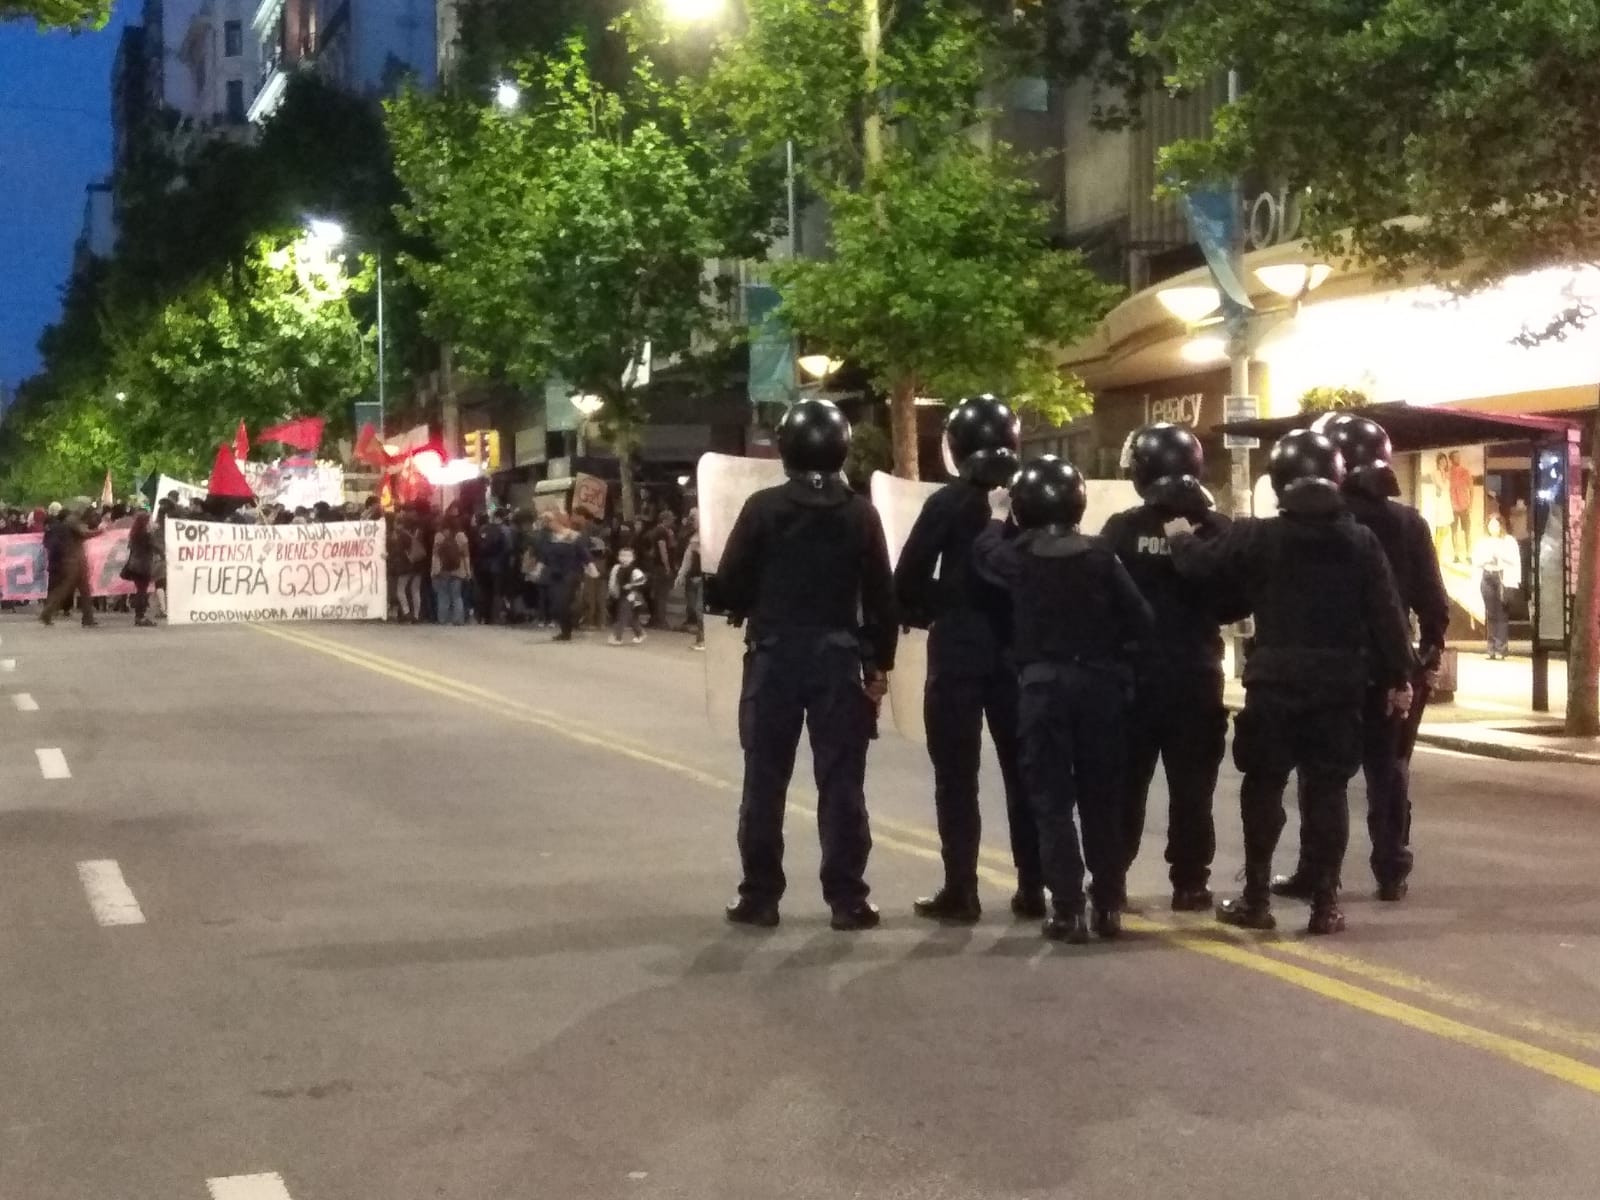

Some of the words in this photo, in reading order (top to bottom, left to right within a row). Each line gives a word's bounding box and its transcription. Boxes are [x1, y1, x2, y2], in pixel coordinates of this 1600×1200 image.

[1144, 393, 1203, 428] Legacy
[175, 521, 209, 542] POR
[196, 544, 254, 562] DEFENSA
[276, 541, 318, 561] BIENES
[322, 539, 376, 560] COMUNES
[192, 565, 270, 596] FUERA
[189, 608, 288, 622] COORDINADORA
